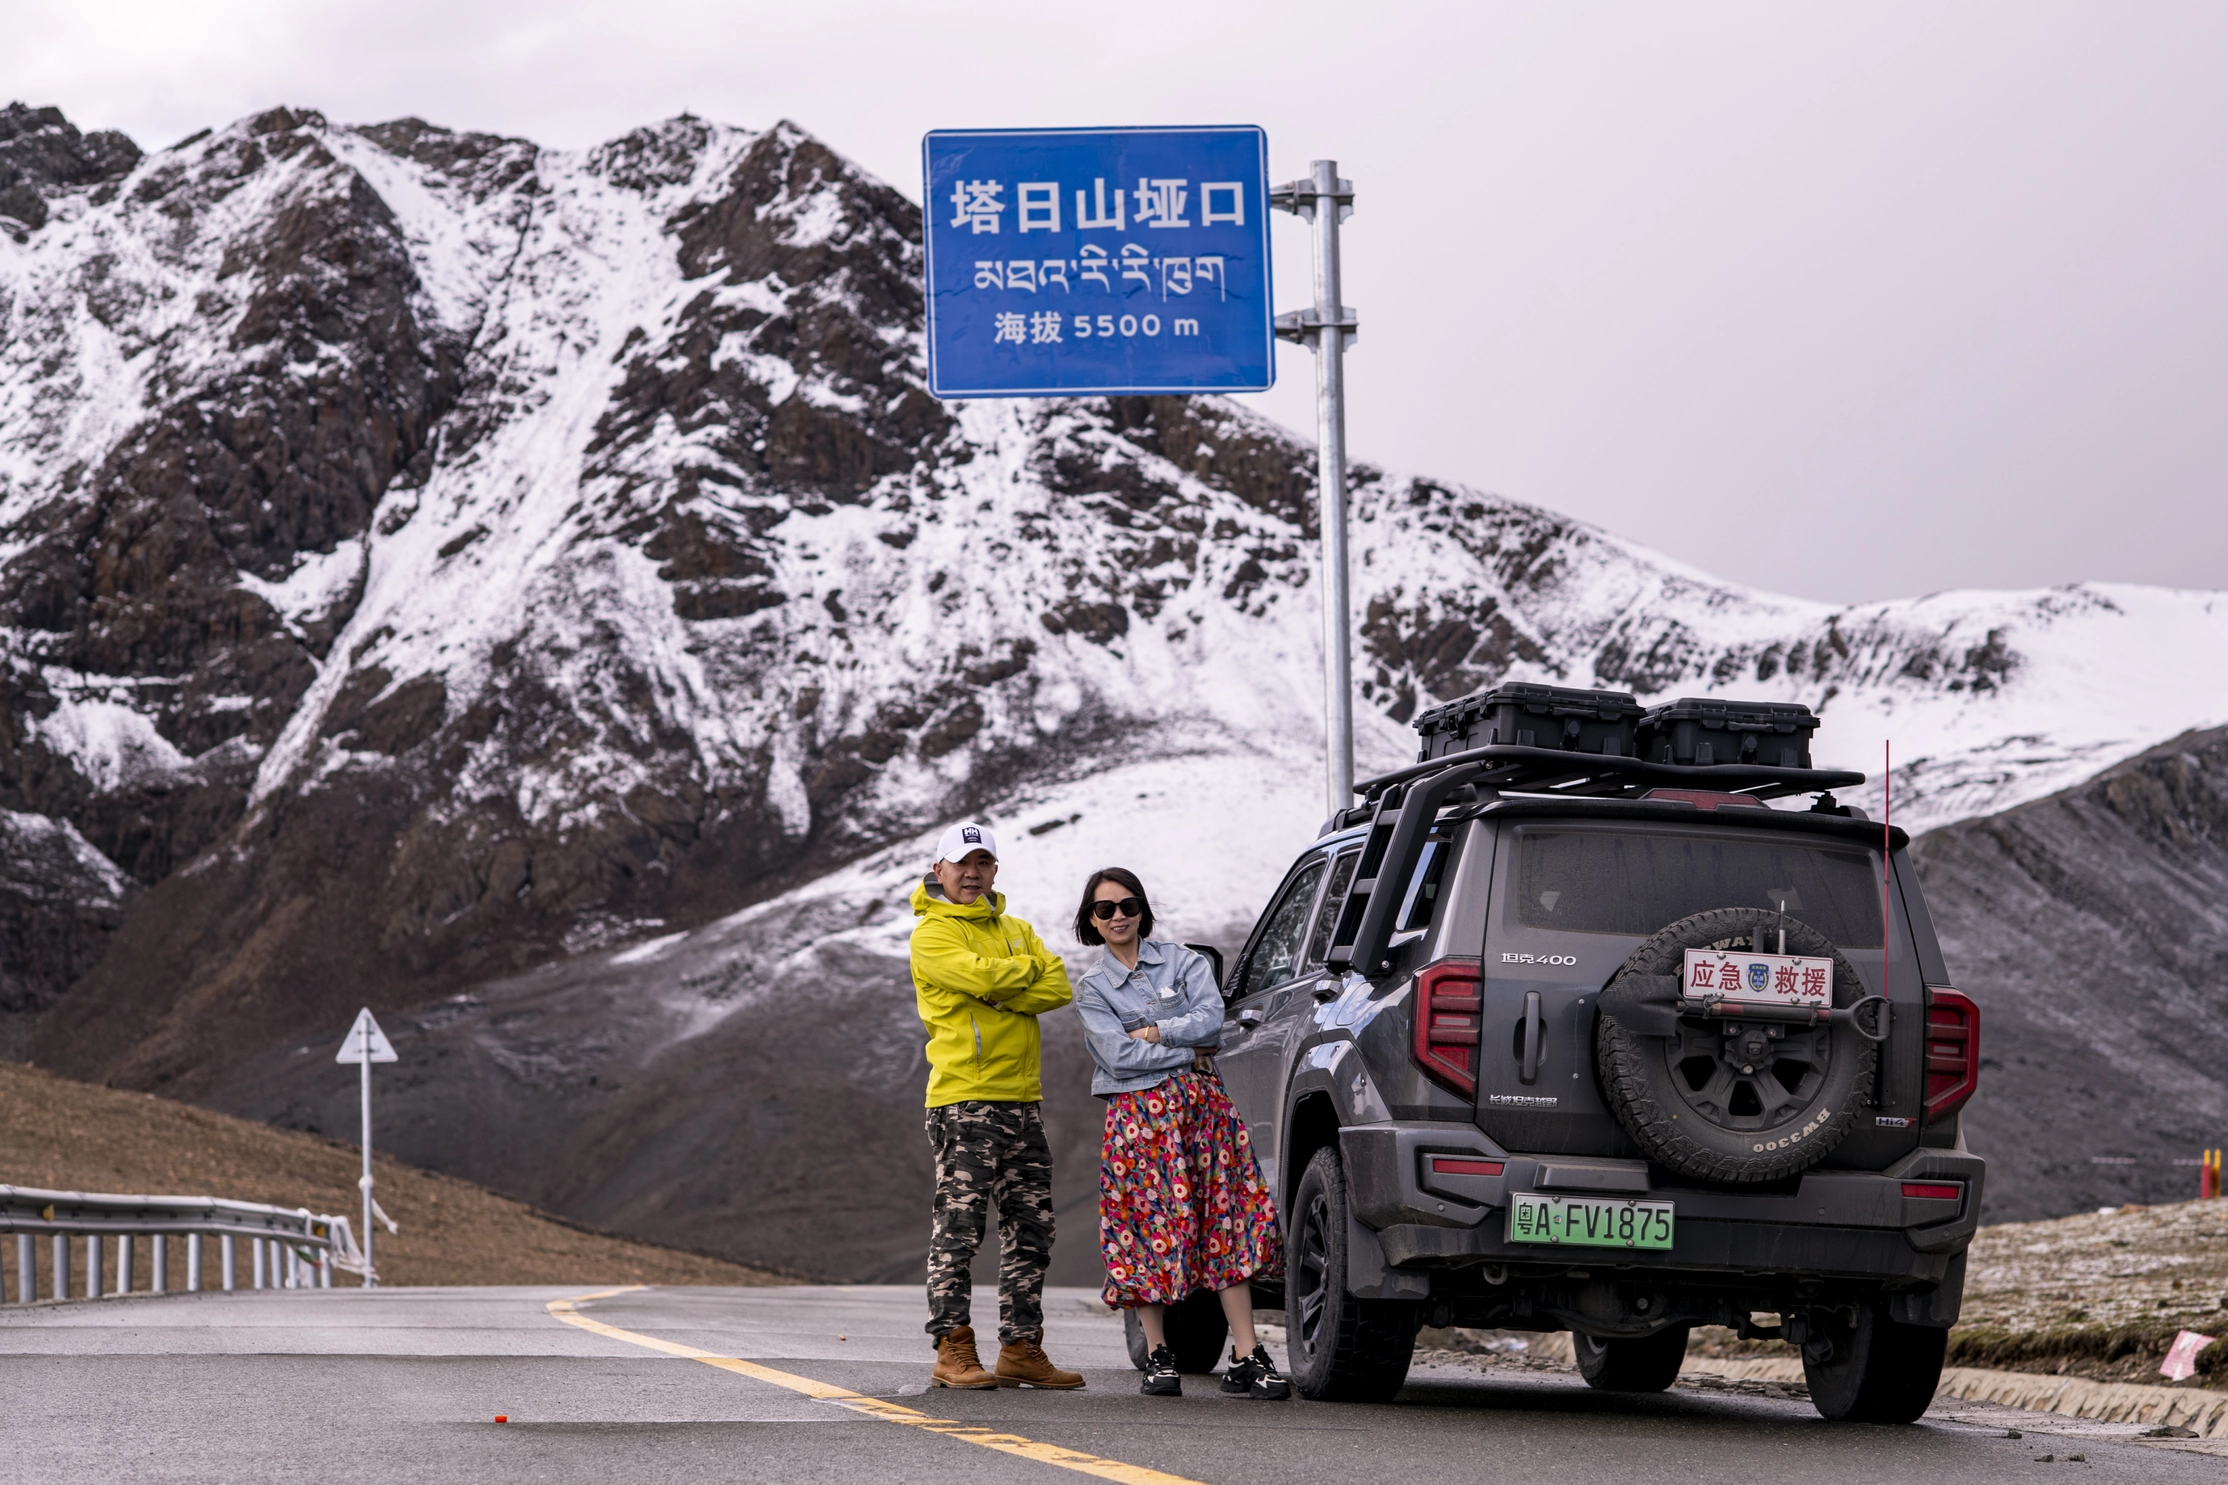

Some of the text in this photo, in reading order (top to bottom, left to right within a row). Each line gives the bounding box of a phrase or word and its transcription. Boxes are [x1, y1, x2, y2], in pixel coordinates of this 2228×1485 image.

[950, 177, 1245, 234] 塔日山垭口
[994, 311, 1199, 344] 海拔 5500 m
[1490, 1094, 1558, 1108] 长城坦克越野
[1752, 1107, 1832, 1153] BW3300
